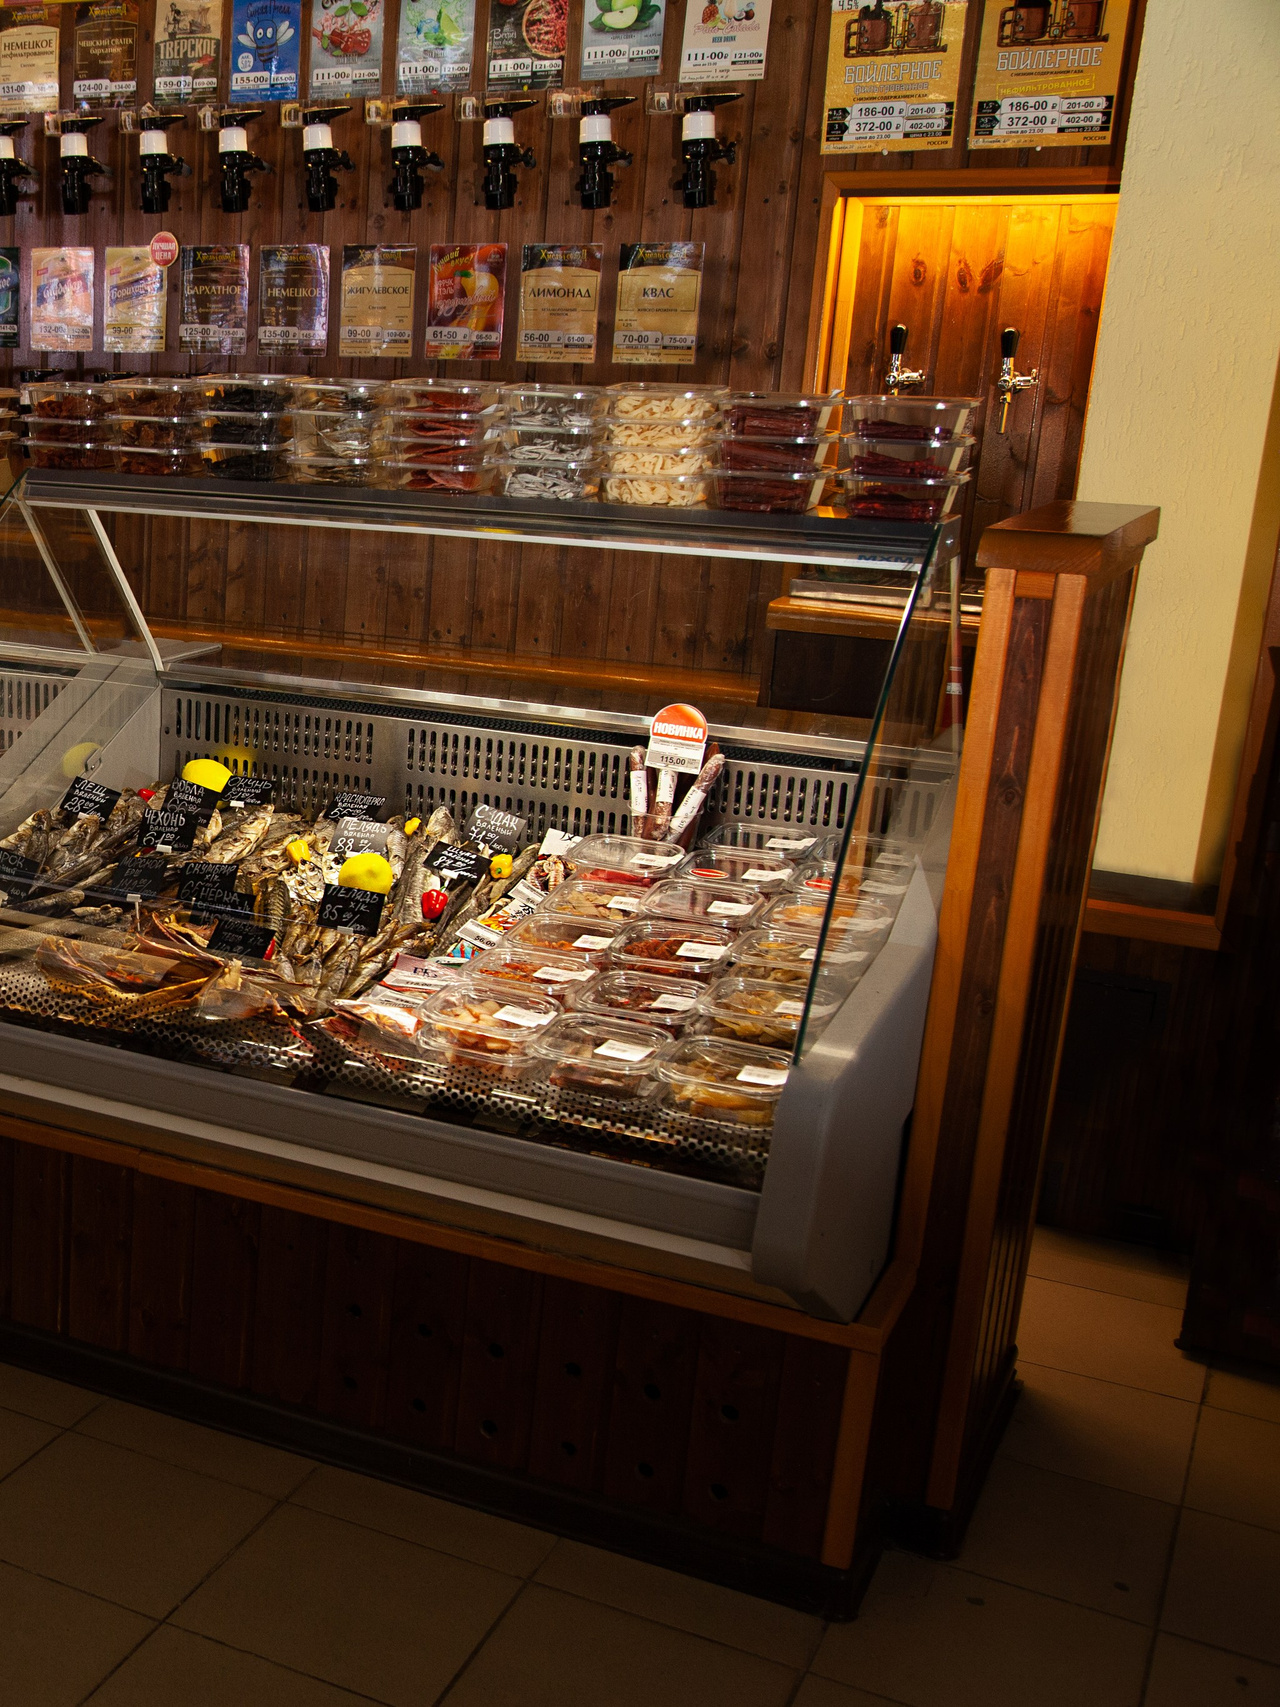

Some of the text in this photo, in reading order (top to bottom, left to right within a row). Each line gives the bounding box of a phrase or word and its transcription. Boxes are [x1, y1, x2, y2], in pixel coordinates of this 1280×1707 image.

[3, 39, 53, 51] НЕМЕЦКОЕ
[160, 38, 217, 60] ТВЕРСКОЕ
[587, 49, 622, 59] 111-00
[631, 48, 656, 56] 121-00
[687, 51, 724, 62] 111-00
[733, 51, 760, 60] 121-00
[996, 47, 1103, 71] БОЙЛЕРНОЕ
[402, 65, 435, 76] 111-00
[492, 62, 525, 72] 111-00
[534, 62, 558, 71] 121-00
[315, 71, 347, 81] 111-00
[844, 60, 942, 84] БОЙЛЕРНОЕ
[235, 75, 267, 85] 155-00
[2, 85, 25, 95] 131-00
[77, 83, 103, 92] 124-00
[853, 82, 929, 96] фильтрованное
[1000, 78, 1090, 95] НЕФИЛЬТРОВАННОЕ
[1008, 100, 1048, 111] 186-00
[1066, 101, 1094, 110] 201-00
[857, 106, 895, 117] 186-00
[910, 107, 936, 115] 201-00
[1007, 115, 1047, 126] 372-00
[1065, 116, 1094, 124] 402-00
[855, 121, 892, 132] 372-00
[909, 122, 935, 130] 402-00
[152, 242, 176, 251] ЛУЧШАЯ
[155, 251, 172, 261] ЦЕНА
[267, 287, 322, 298] НЕМЕЦКОЕ
[347, 286, 409, 296] ЖИГУЛЕВСКОЕ
[529, 287, 592, 299] ЛИМОНАД
[642, 287, 675, 298] КВАС
[112, 326, 134, 334] 99-00
[184, 327, 211, 336] 125-00
[263, 329, 290, 338] 135-00
[347, 329, 371, 338] 99-00
[432, 329, 457, 339] 61-50
[524, 333, 550, 342] 56-00
[567, 335, 585, 343] 61-00
[622, 334, 649, 344] 70-00
[669, 336, 688, 344] 75-00
[653, 721, 705, 740] НОВИНКА
[660, 755, 686, 767] 115,00
[144, 809, 187, 828] ЧЕХОНЬ
[340, 818, 388, 834] ПЕЛЯДЬ
[328, 885, 380, 904] ПЕЛЯДЬ
[474, 935, 496, 948] 56,00
